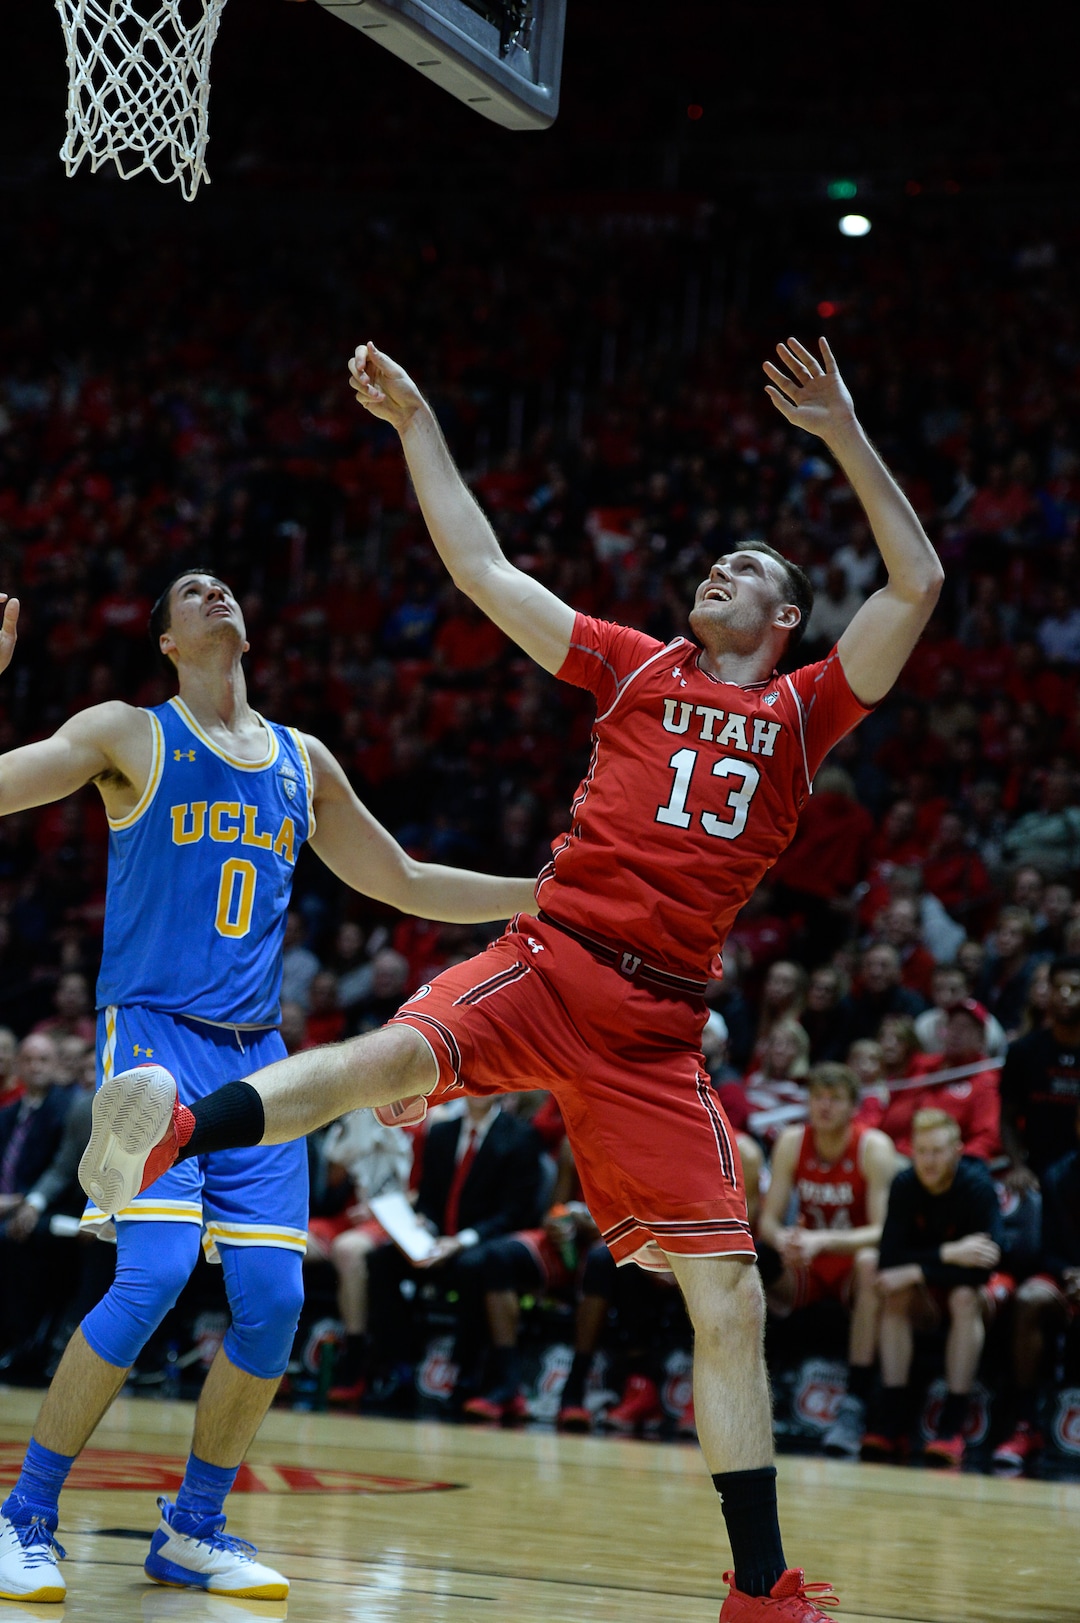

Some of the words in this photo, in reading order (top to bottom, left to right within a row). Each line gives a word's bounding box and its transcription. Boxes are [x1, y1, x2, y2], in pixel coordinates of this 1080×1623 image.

[663, 699, 782, 757] UTAH
[655, 747, 761, 840] 13
[170, 801, 295, 866] UCLA
[215, 857, 257, 939] 0
[621, 952, 641, 975] U
